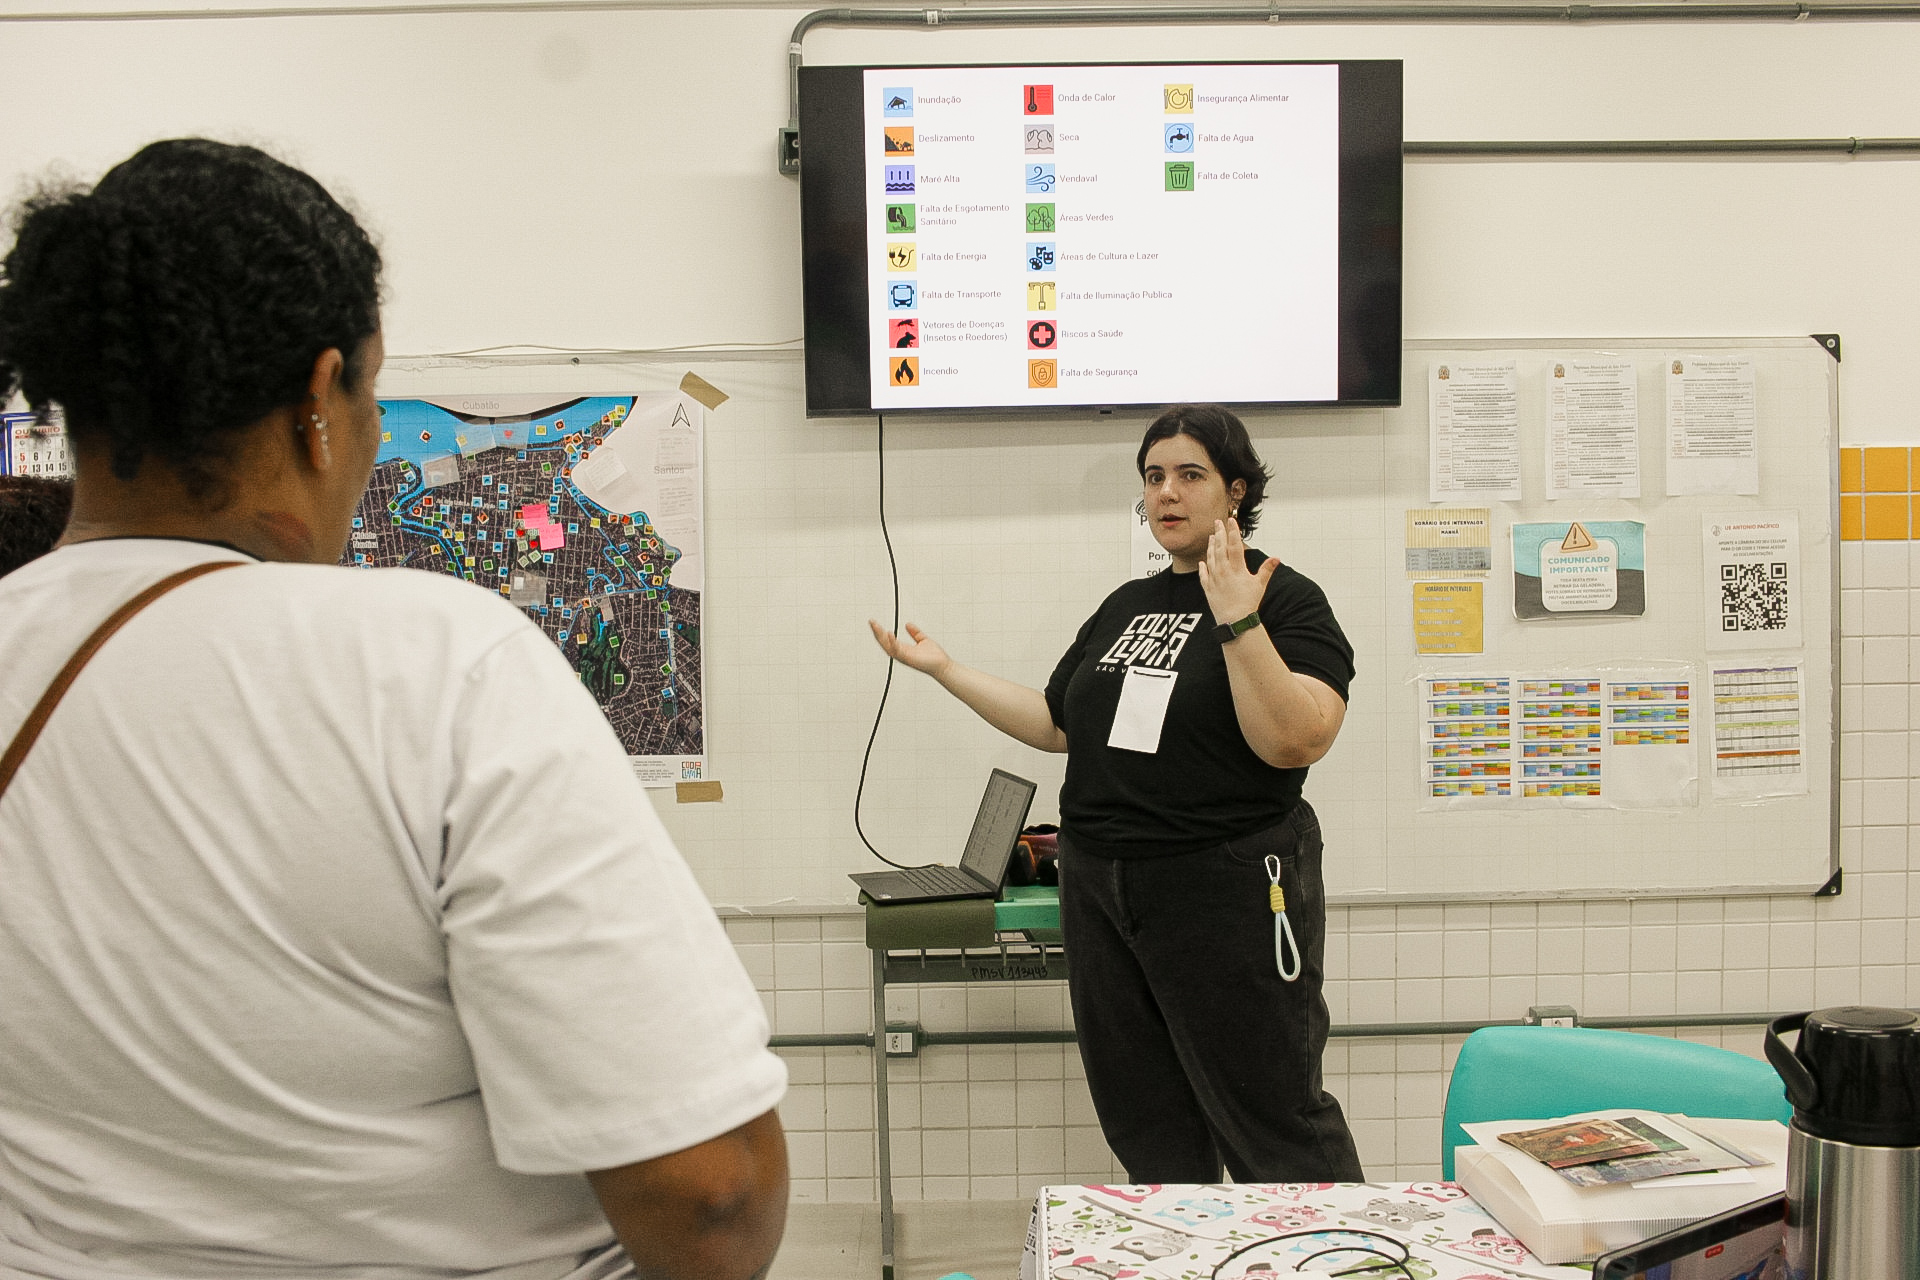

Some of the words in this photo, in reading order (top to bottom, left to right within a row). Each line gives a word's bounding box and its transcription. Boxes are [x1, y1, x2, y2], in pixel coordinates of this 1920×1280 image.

[917, 95, 962, 106] Inundação
[1057, 93, 1080, 102] Onda
[1081, 93, 1093, 102] de
[1094, 92, 1116, 102] Calor
[1197, 94, 1248, 105] Insegurança
[1249, 93, 1290, 103] Alimentar
[918, 133, 975, 143] Deslizamento
[1059, 133, 1080, 142] Seca
[1198, 133, 1219, 143] Falta
[1220, 133, 1232, 143] de
[943, 174, 961, 183] Alta
[1059, 173, 1098, 183] Vendaval
[1197, 171, 1218, 180] Falta
[1219, 171, 1231, 180] de
[1232, 171, 1259, 180] Coleta
[920, 204, 941, 213] Falta
[942, 204, 953, 213] de
[954, 204, 1010, 214] Esgotamento
[1085, 212, 1114, 222] Verdes
[921, 252, 942, 261] Falta
[943, 252, 954, 261] de
[955, 252, 987, 262] Energia
[1085, 252, 1097, 261] de
[1098, 251, 1128, 261] Cultura
[1136, 251, 1159, 260] Lazer
[921, 290, 943, 299] Falta
[944, 290, 955, 299] de
[956, 290, 1002, 300] Transporte
[1060, 291, 1081, 300] Falta
[1082, 291, 1094, 300] de
[922, 320, 955, 329] Vetores
[956, 320, 967, 329] de
[968, 320, 1005, 330] Doenças
[923, 333, 957, 344] (Insetos
[958, 334, 964, 342] e
[965, 332, 1008, 342] Roedores)
[1061, 329, 1089, 339] Riscos
[1060, 368, 1081, 377] Falta
[1082, 368, 1094, 377] de
[1095, 368, 1138, 378] Segurança
[462, 401, 500, 411] Cubatão
[20, 452, 26, 462] 5
[33, 452, 39, 461] 6
[47, 451, 52, 461] 7
[60, 450, 65, 460] 8
[19, 464, 28, 474] 12
[32, 464, 41, 473] 13
[45, 463, 54, 472] 14
[59, 462, 67, 472] 15
[654, 465, 685, 475] Santos
[1148, 551, 1166, 561] Por
[1547, 556, 1610, 565] COMUNICADO
[1549, 566, 1609, 574] IMPORTANTE
[1095, 664, 1116, 673] SÃO
